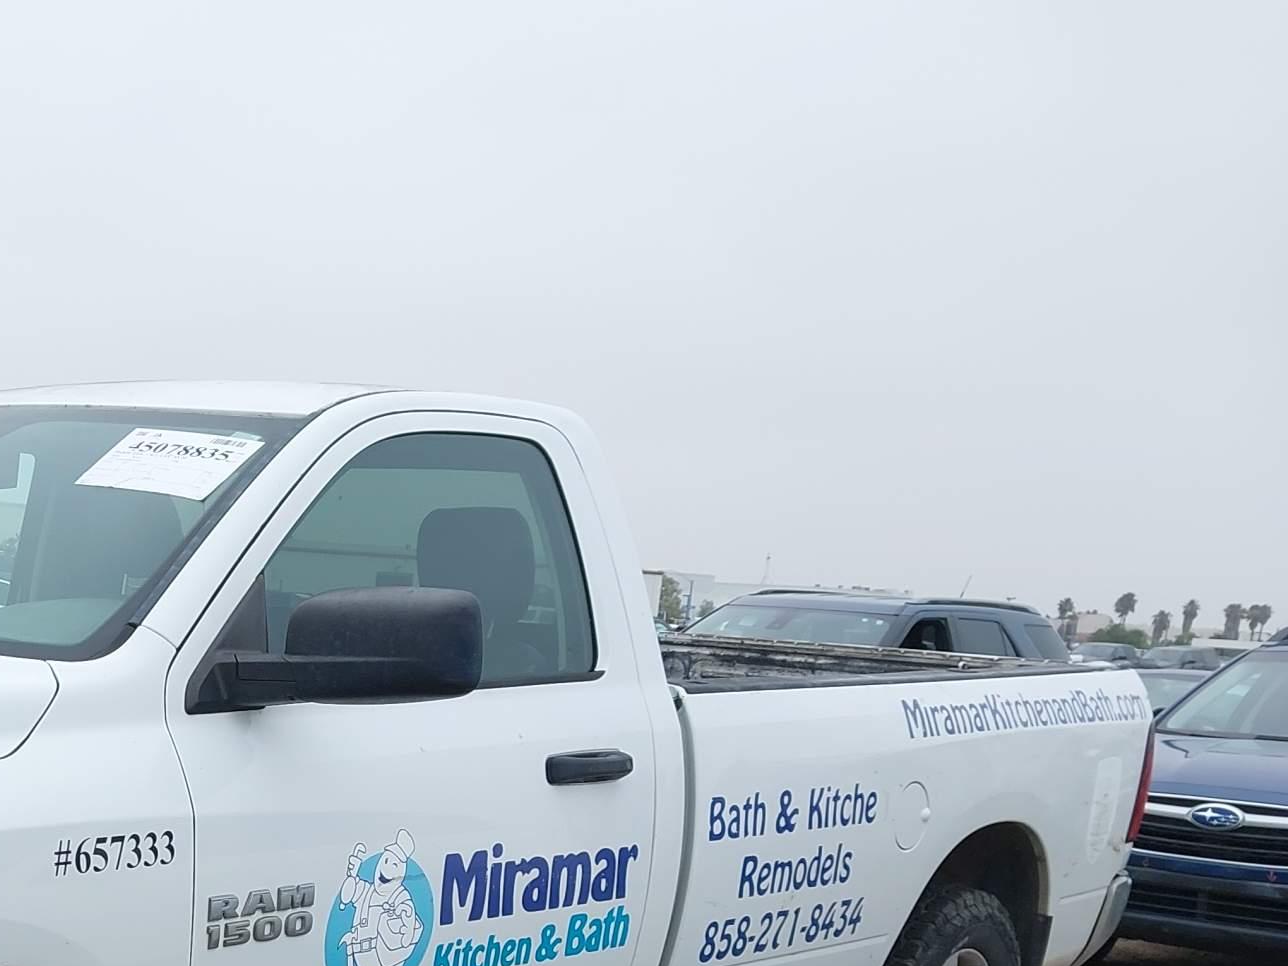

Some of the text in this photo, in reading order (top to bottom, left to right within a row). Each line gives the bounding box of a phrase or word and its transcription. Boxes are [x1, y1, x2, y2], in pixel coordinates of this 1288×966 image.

[128, 440, 235, 462] 45078835
[902, 688, 1148, 739] MiramarKitchenandBath.com
[709, 783, 878, 842] Bath & Kitche
[53, 830, 175, 877] #657333
[738, 843, 852, 899] Remodels
[207, 883, 316, 923] RAM
[439, 843, 640, 927] Miramar
[206, 911, 314, 950] 1500
[534, 923, 561, 963] &
[564, 905, 631, 958] Bath
[698, 897, 864, 964] 858-271-8434
